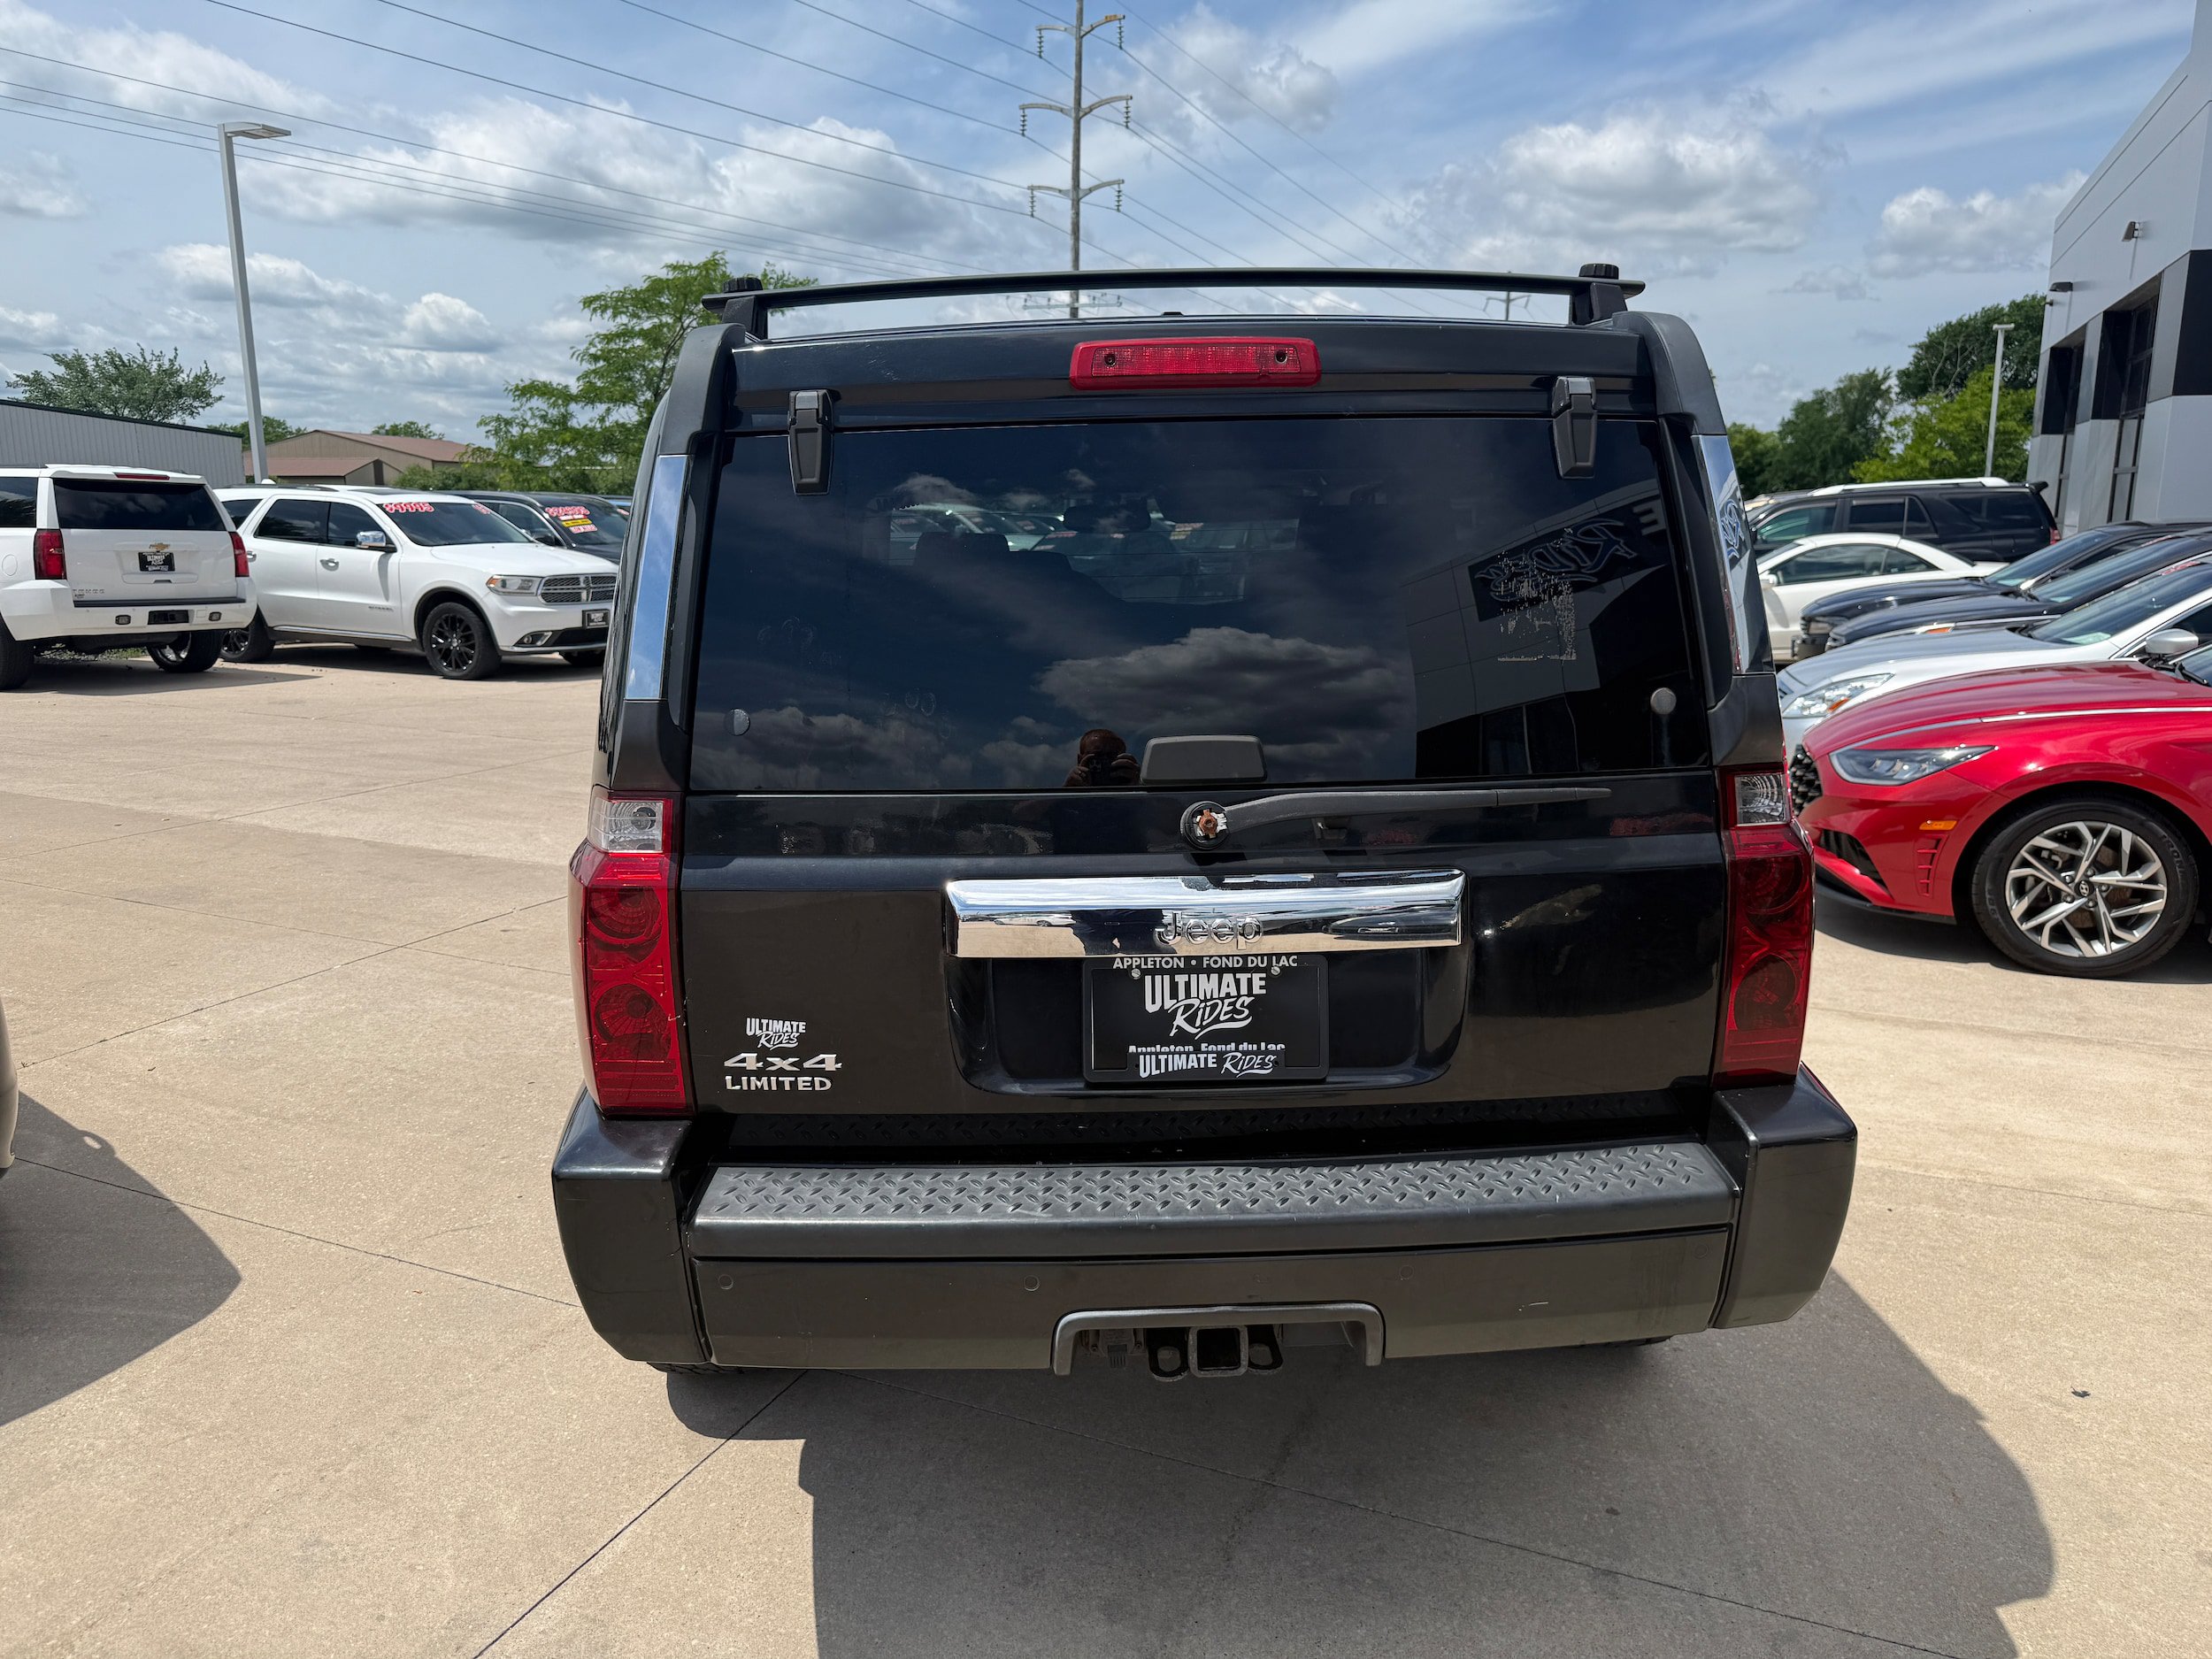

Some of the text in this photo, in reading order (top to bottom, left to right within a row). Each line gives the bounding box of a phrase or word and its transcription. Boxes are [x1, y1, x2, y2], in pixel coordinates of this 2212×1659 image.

[1153, 910, 1262, 950] Jeep
[1113, 955, 1298, 970] APPLETON FOND DU LAC
[1144, 973, 1267, 1014] ULTIMATE
[746, 1018, 806, 1036] ULTIMATE
[724, 1052, 843, 1071] 4x4
[1139, 1053, 1217, 1079] ULTIMATE
[725, 1075, 832, 1091] LIMITED
